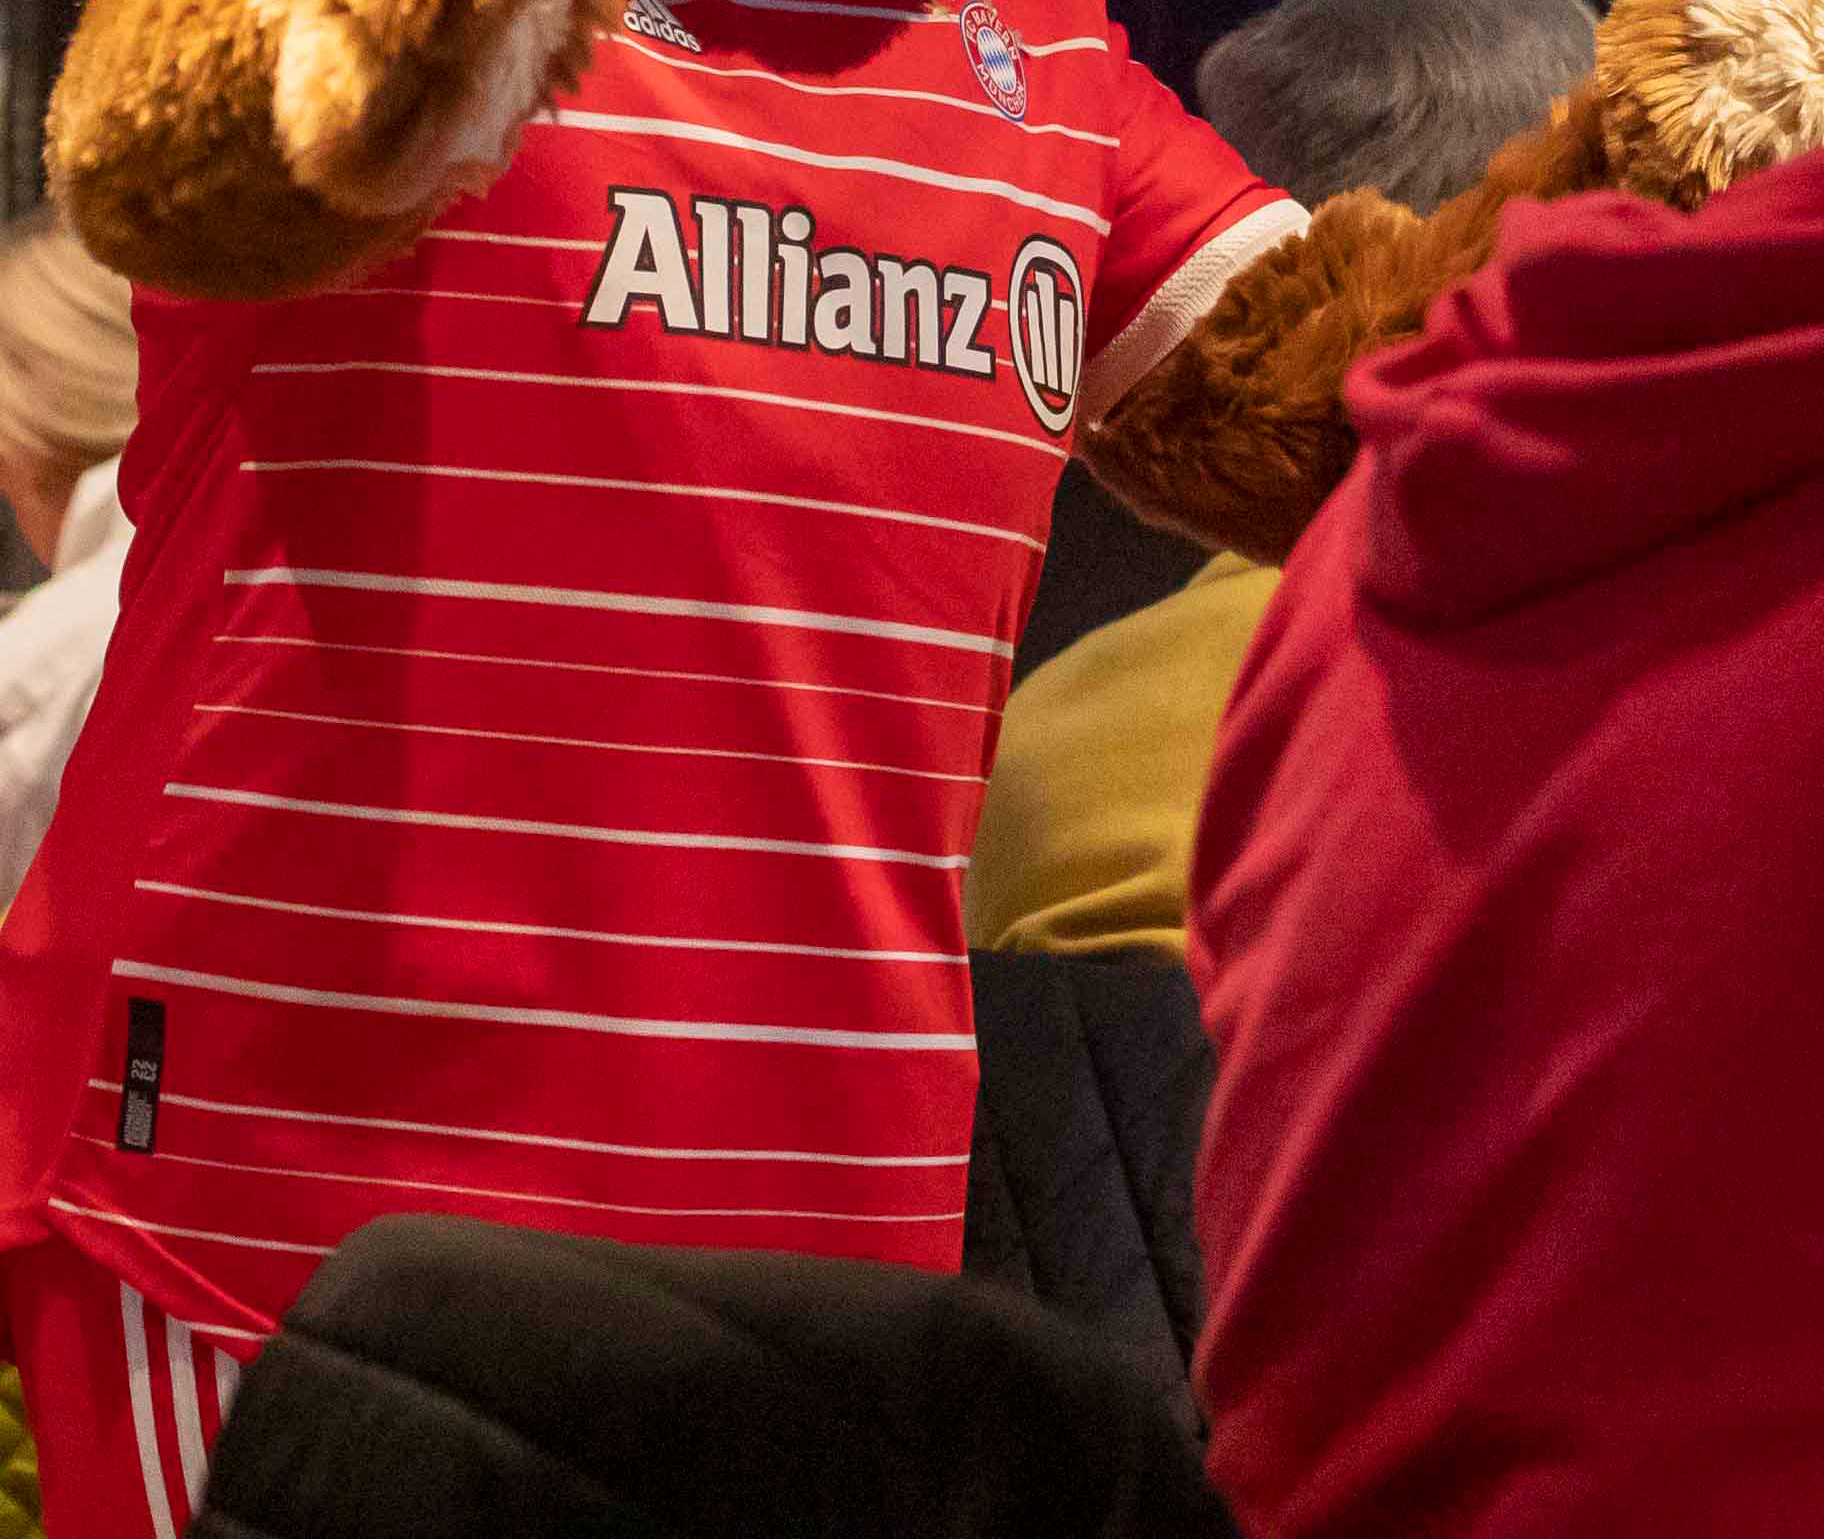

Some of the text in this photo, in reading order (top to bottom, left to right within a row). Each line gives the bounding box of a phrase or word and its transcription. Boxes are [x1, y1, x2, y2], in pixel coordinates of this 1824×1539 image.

[623, 11, 702, 53] adidas
[971, 8, 1018, 61] BAYERN
[583, 188, 995, 377] Allianz
